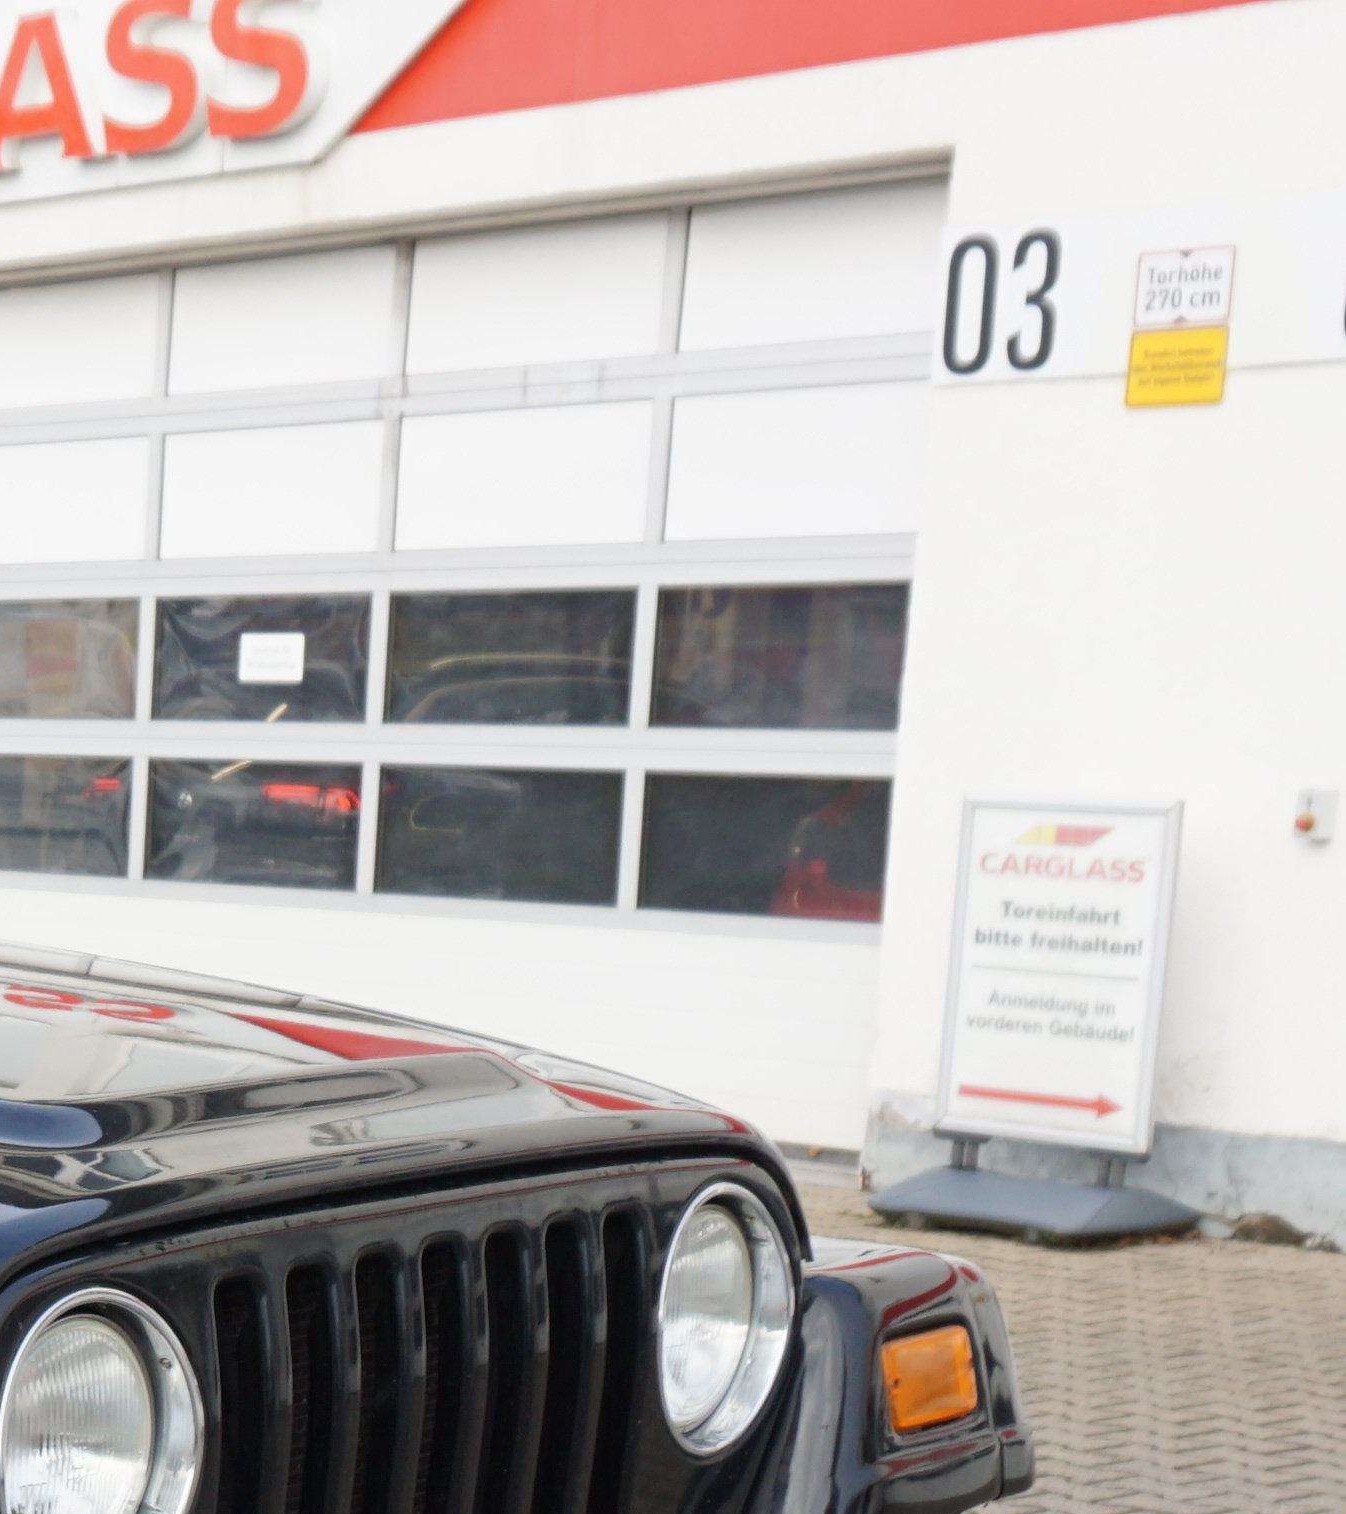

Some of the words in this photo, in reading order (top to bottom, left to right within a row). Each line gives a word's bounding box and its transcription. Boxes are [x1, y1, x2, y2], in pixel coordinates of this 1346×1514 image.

[943, 227, 1062, 375] 03
[1145, 288, 1182, 312] 270
[1189, 289, 1222, 308] cm
[978, 852, 1147, 884] CARGLASS
[1001, 900, 1121, 926] Toreinfahrt
[974, 928, 1022, 947] bitte
[1030, 929, 1144, 957] freihalten!
[988, 989, 1088, 1018] Anmeldung
[1094, 1001, 1117, 1017] im
[966, 1014, 1043, 1035] vorderen
